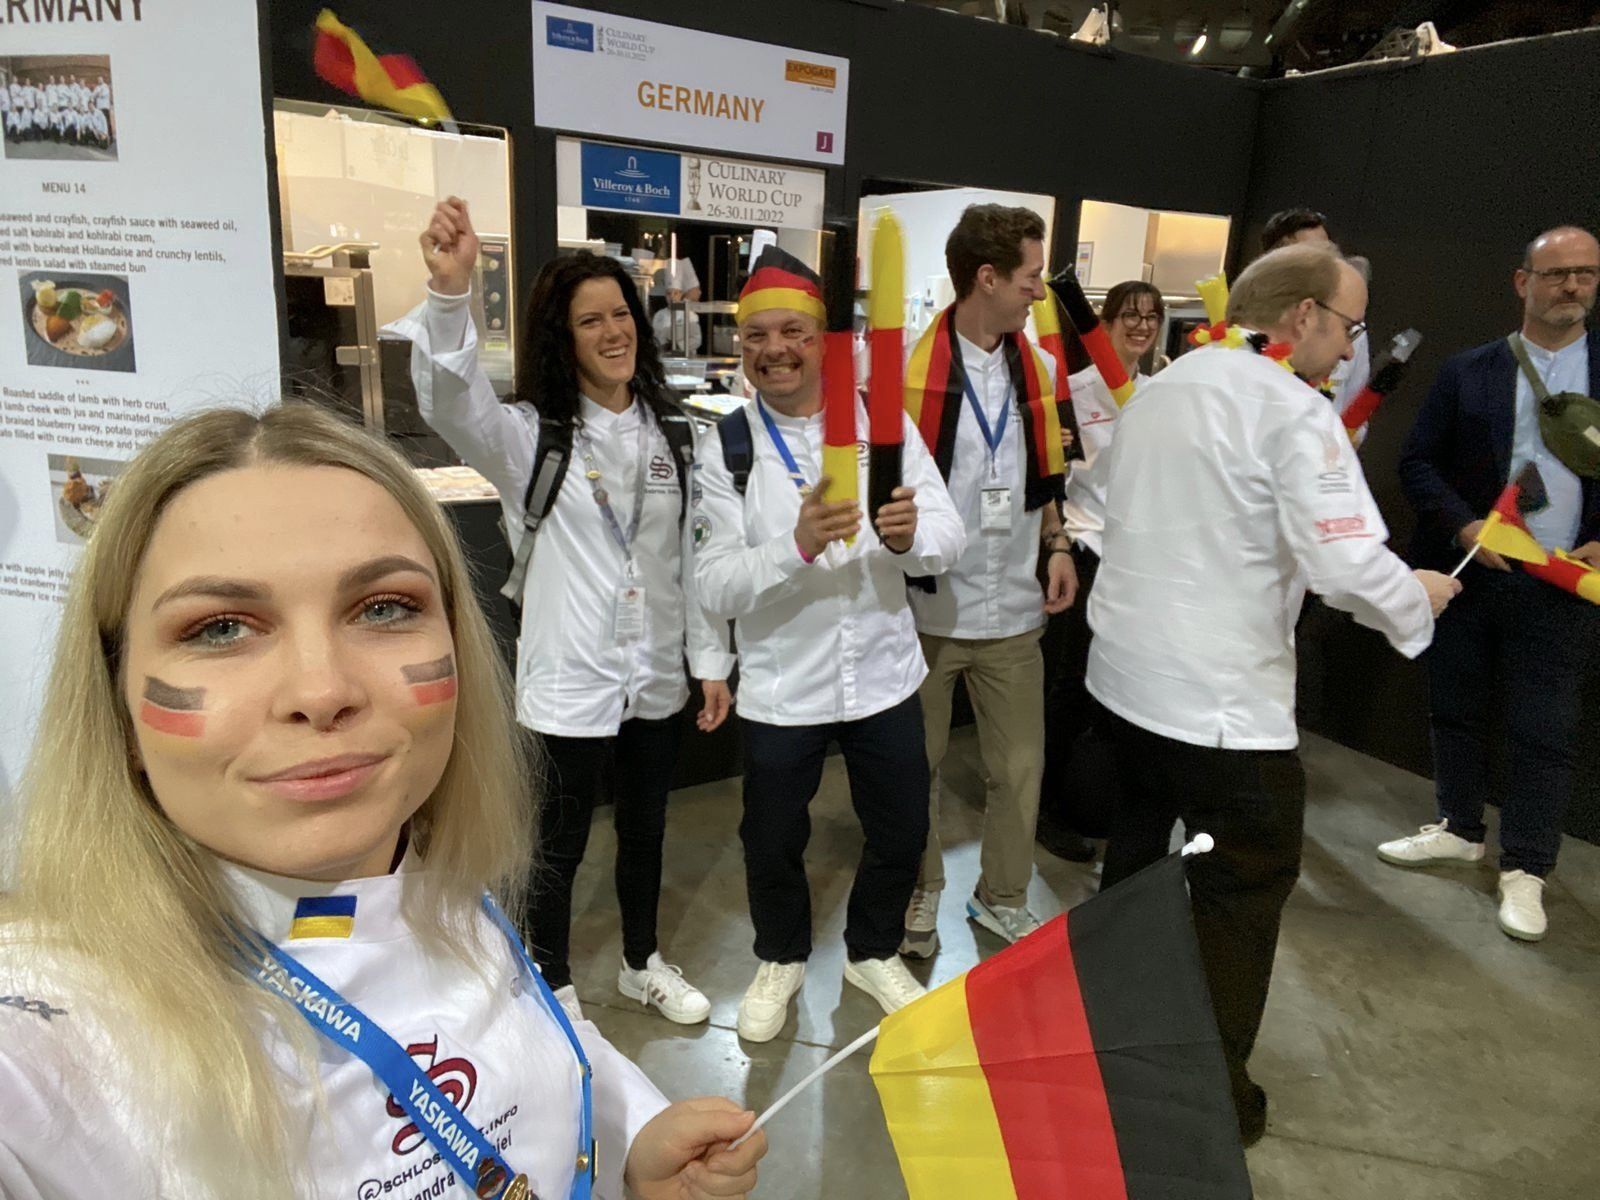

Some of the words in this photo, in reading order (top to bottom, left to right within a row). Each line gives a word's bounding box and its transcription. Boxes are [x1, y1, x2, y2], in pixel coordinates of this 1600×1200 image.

[0, 0, 142, 23] RMANY
[606, 27, 647, 42] CULINARY
[607, 38, 637, 51] WORLD
[638, 43, 656, 54] CUP
[637, 80, 765, 123] GERMANY
[821, 135, 828, 150] J
[707, 160, 787, 186] CULINARY
[42, 182, 71, 194] MENU
[74, 182, 87, 194] 14
[593, 177, 634, 193] Villeroy
[635, 184, 643, 193] &
[645, 183, 671, 196] Boch
[708, 182, 768, 204] WORLD
[770, 189, 802, 207] CUP
[0, 213, 33, 222] eaweed
[35, 214, 51, 223] and
[93, 215, 127, 228] crayfish
[129, 217, 155, 227] sauce
[158, 217, 178, 228] with
[180, 219, 220, 230] seaweed
[707, 203, 785, 224] 26-30.11.2022
[68, 229, 84, 239] and
[87, 231, 122, 242] kohlrabi
[13, 242, 31, 252] with
[33, 243, 79, 253] buckwheat
[82, 244, 133, 257] Hollandaise
[136, 248, 153, 258] and
[155, 249, 192, 262] crunchy
[15, 256, 41, 267] lentils
[43, 258, 66, 268] salad
[68, 259, 87, 269] with
[89, 260, 126, 272] steamed
[129, 263, 146, 273] bun
[38, 391, 65, 402] saddle
[67, 393, 76, 403] of
[78, 393, 99, 404] lamb
[102, 396, 120, 407] with
[122, 397, 143, 408] herb
[145, 399, 170, 412] crust,
[4, 401, 25, 412] lamb
[27, 404, 51, 415] cheek
[53, 407, 71, 416] with
[74, 407, 87, 419] jus
[89, 410, 105, 419] and
[107, 411, 150, 424] marinated
[5, 415, 35, 426] braised
[37, 417, 76, 432] blueberry
[105, 424, 132, 436] potato
[37, 431, 55, 442] with
[57, 435, 83, 445] cream
[85, 436, 114, 448] cheese
[116, 439, 132, 449] and
[6, 563, 22, 571] with
[24, 566, 46, 576] apple
[4, 576, 18, 585] and
[20, 578, 56, 590] cranberry
[256, 955, 362, 1043] YASKAWA
[407, 1077, 481, 1172] YASKAWA
